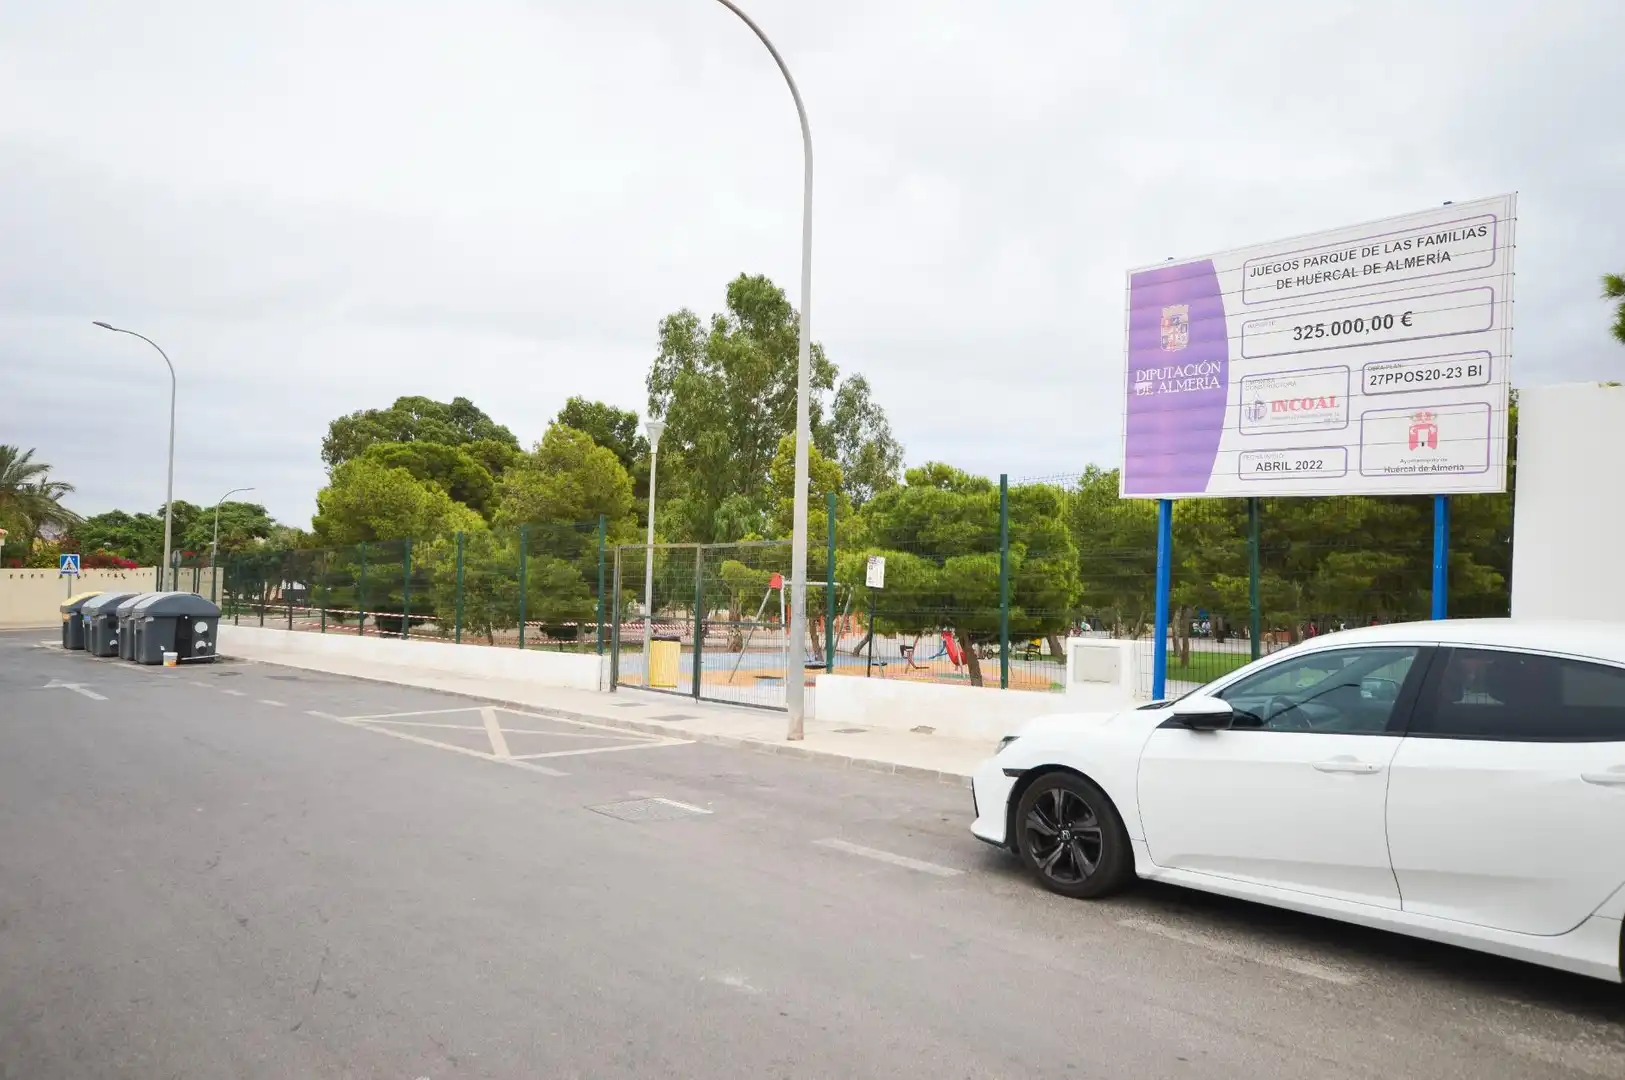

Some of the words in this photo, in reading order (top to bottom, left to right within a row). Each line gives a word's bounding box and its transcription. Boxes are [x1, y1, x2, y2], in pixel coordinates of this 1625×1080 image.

[1250, 260, 1300, 278] JUEGOS
[1303, 249, 1357, 268] PARQUE
[1361, 245, 1380, 258] DE
[1384, 239, 1412, 254] LAS
[1417, 225, 1488, 248] FAMILIAS
[1276, 277, 1293, 290] DE
[1363, 262, 1382, 276] DE
[1385, 249, 1452, 272] ALMERÍA
[1293, 313, 1394, 341] 325.000,00
[1400, 310, 1413, 327] €
[1135, 359, 1222, 383] DIPUTACIÓN
[1370, 366, 1462, 386] 27PPOS20-23
[1467, 364, 1482, 377] BI
[1134, 381, 1154, 396] DE
[1157, 374, 1221, 394] ALMERÍA
[1271, 395, 1340, 412] INCOAL
[1255, 461, 1291, 472] ABRIL
[1295, 459, 1323, 471] 2022
[1418, 463, 1430, 472] de
